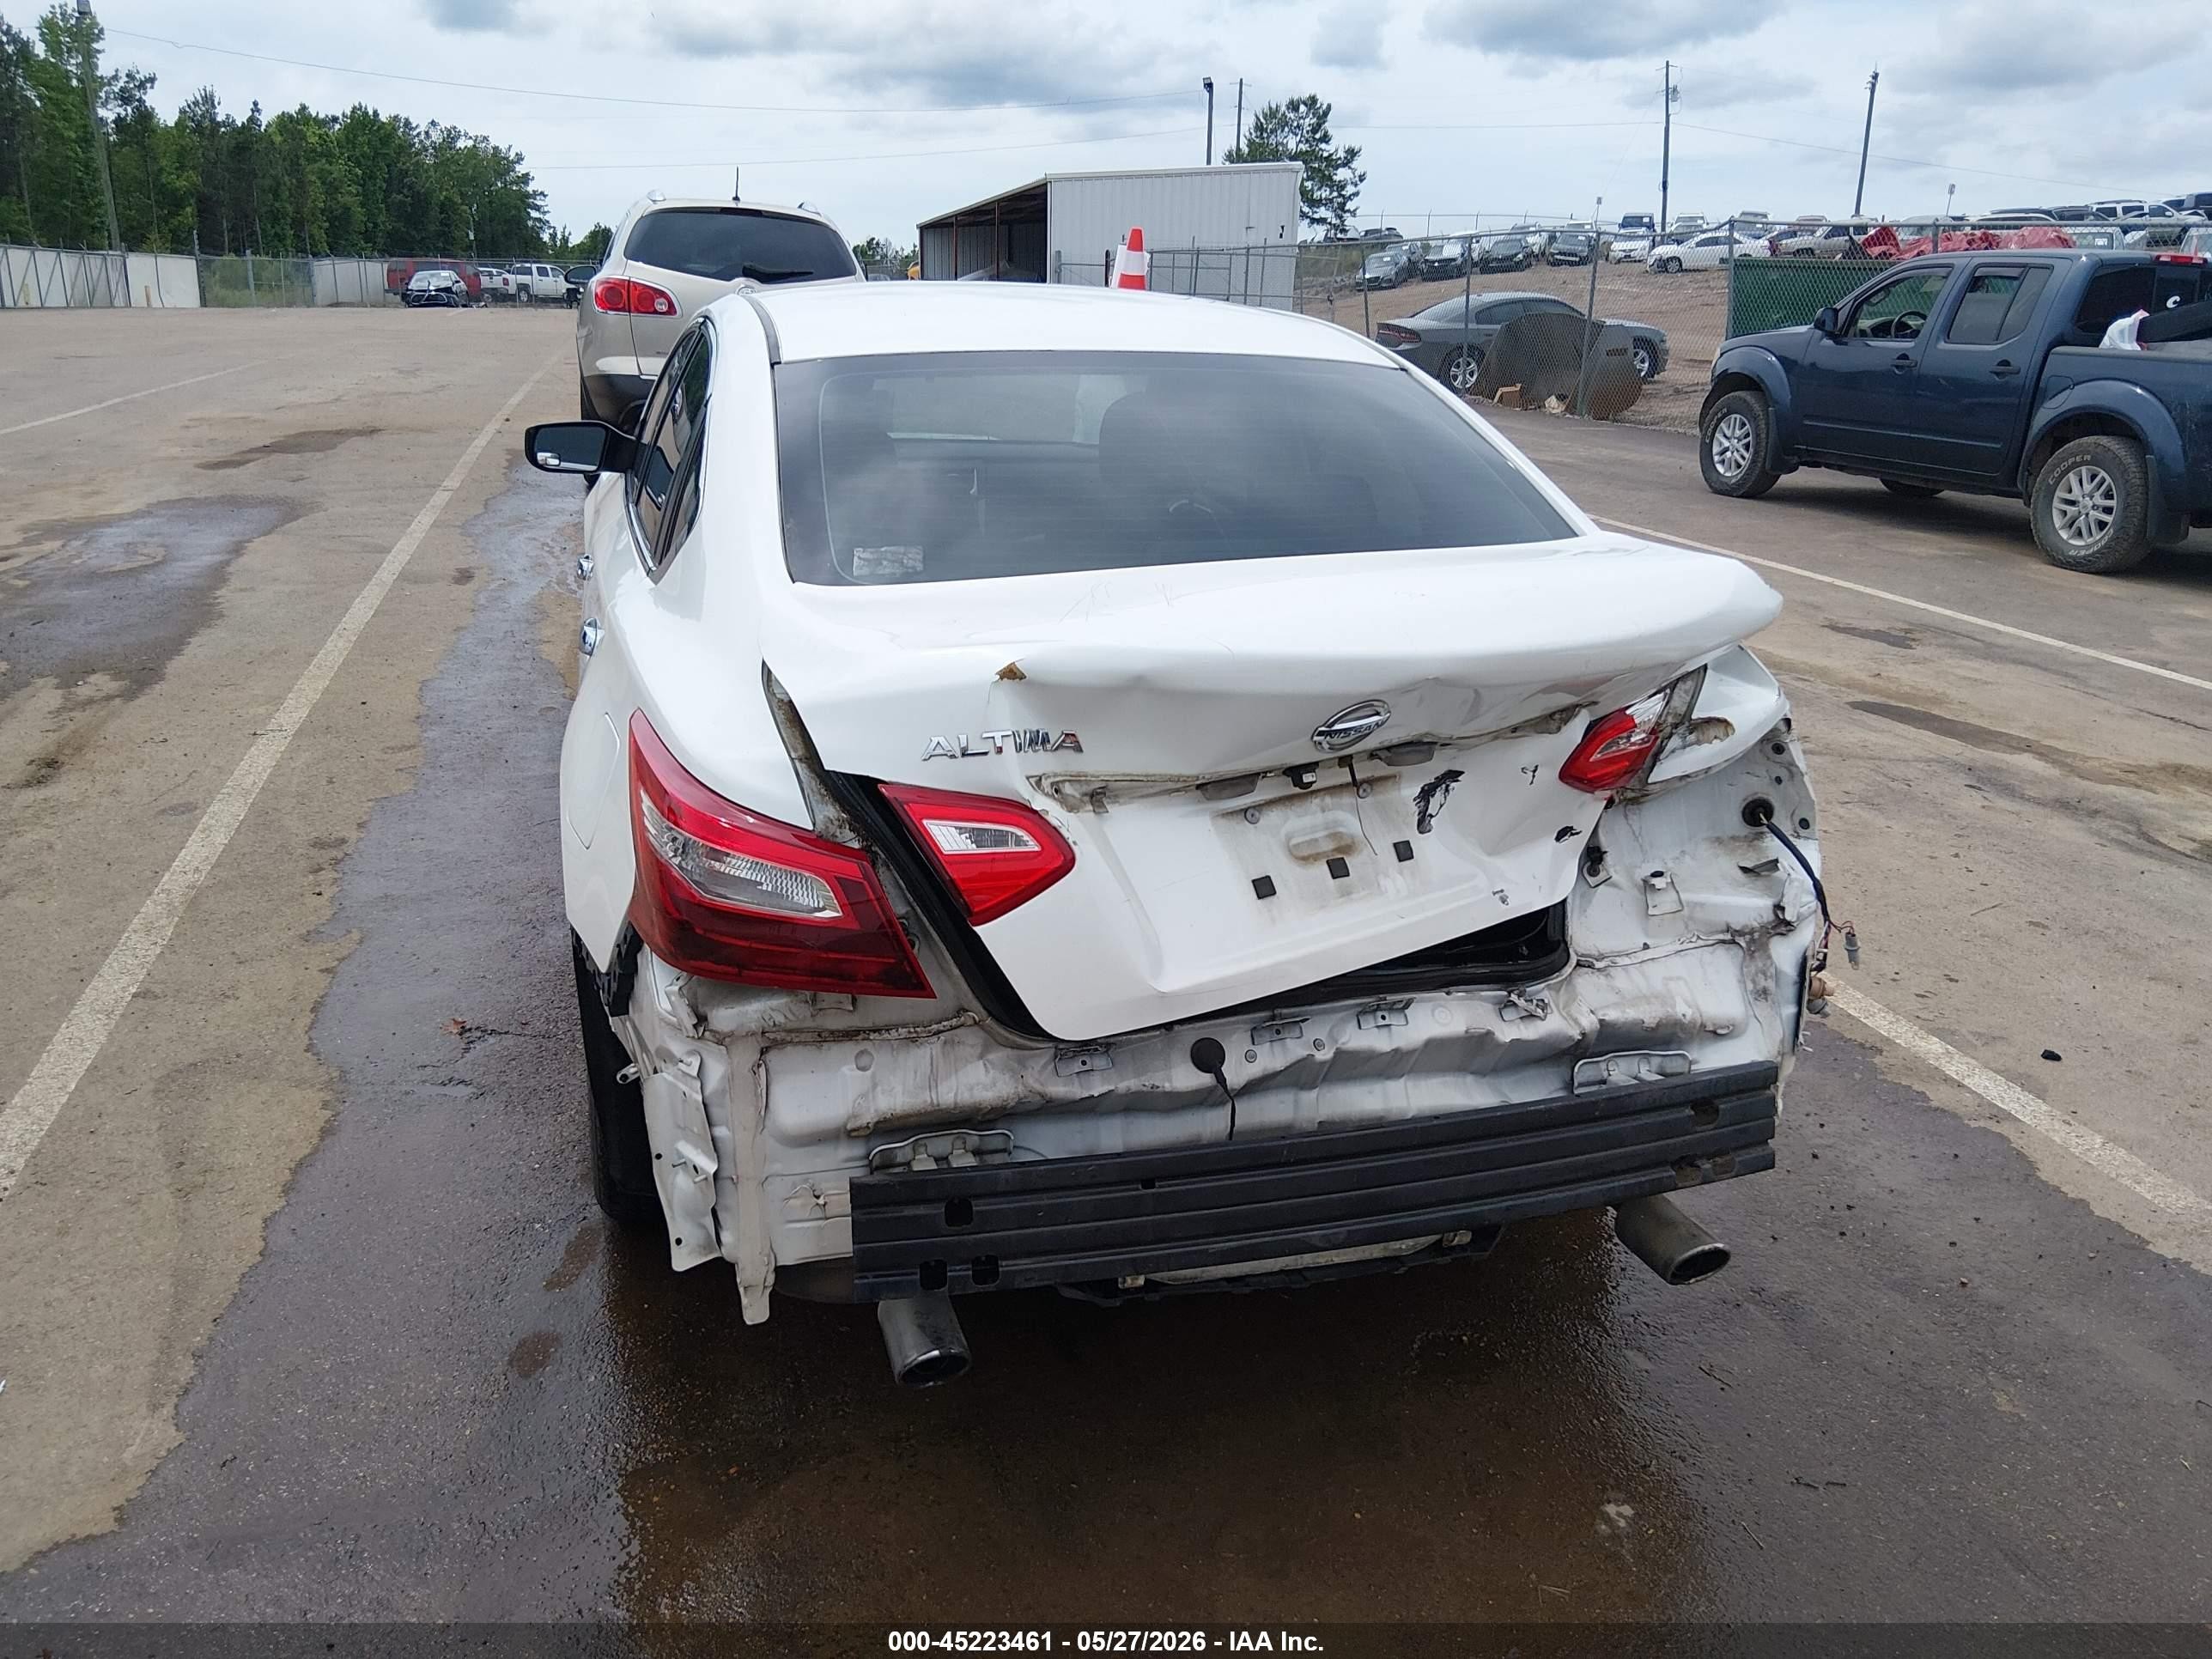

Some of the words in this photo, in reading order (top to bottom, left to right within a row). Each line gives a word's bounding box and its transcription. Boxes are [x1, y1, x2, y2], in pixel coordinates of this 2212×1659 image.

[1705, 407, 1728, 443] COOPER
[2048, 454, 2092, 485] COOPER
[921, 728, 1084, 762] ALTIMA
[1323, 719, 1387, 739] NISSAN
